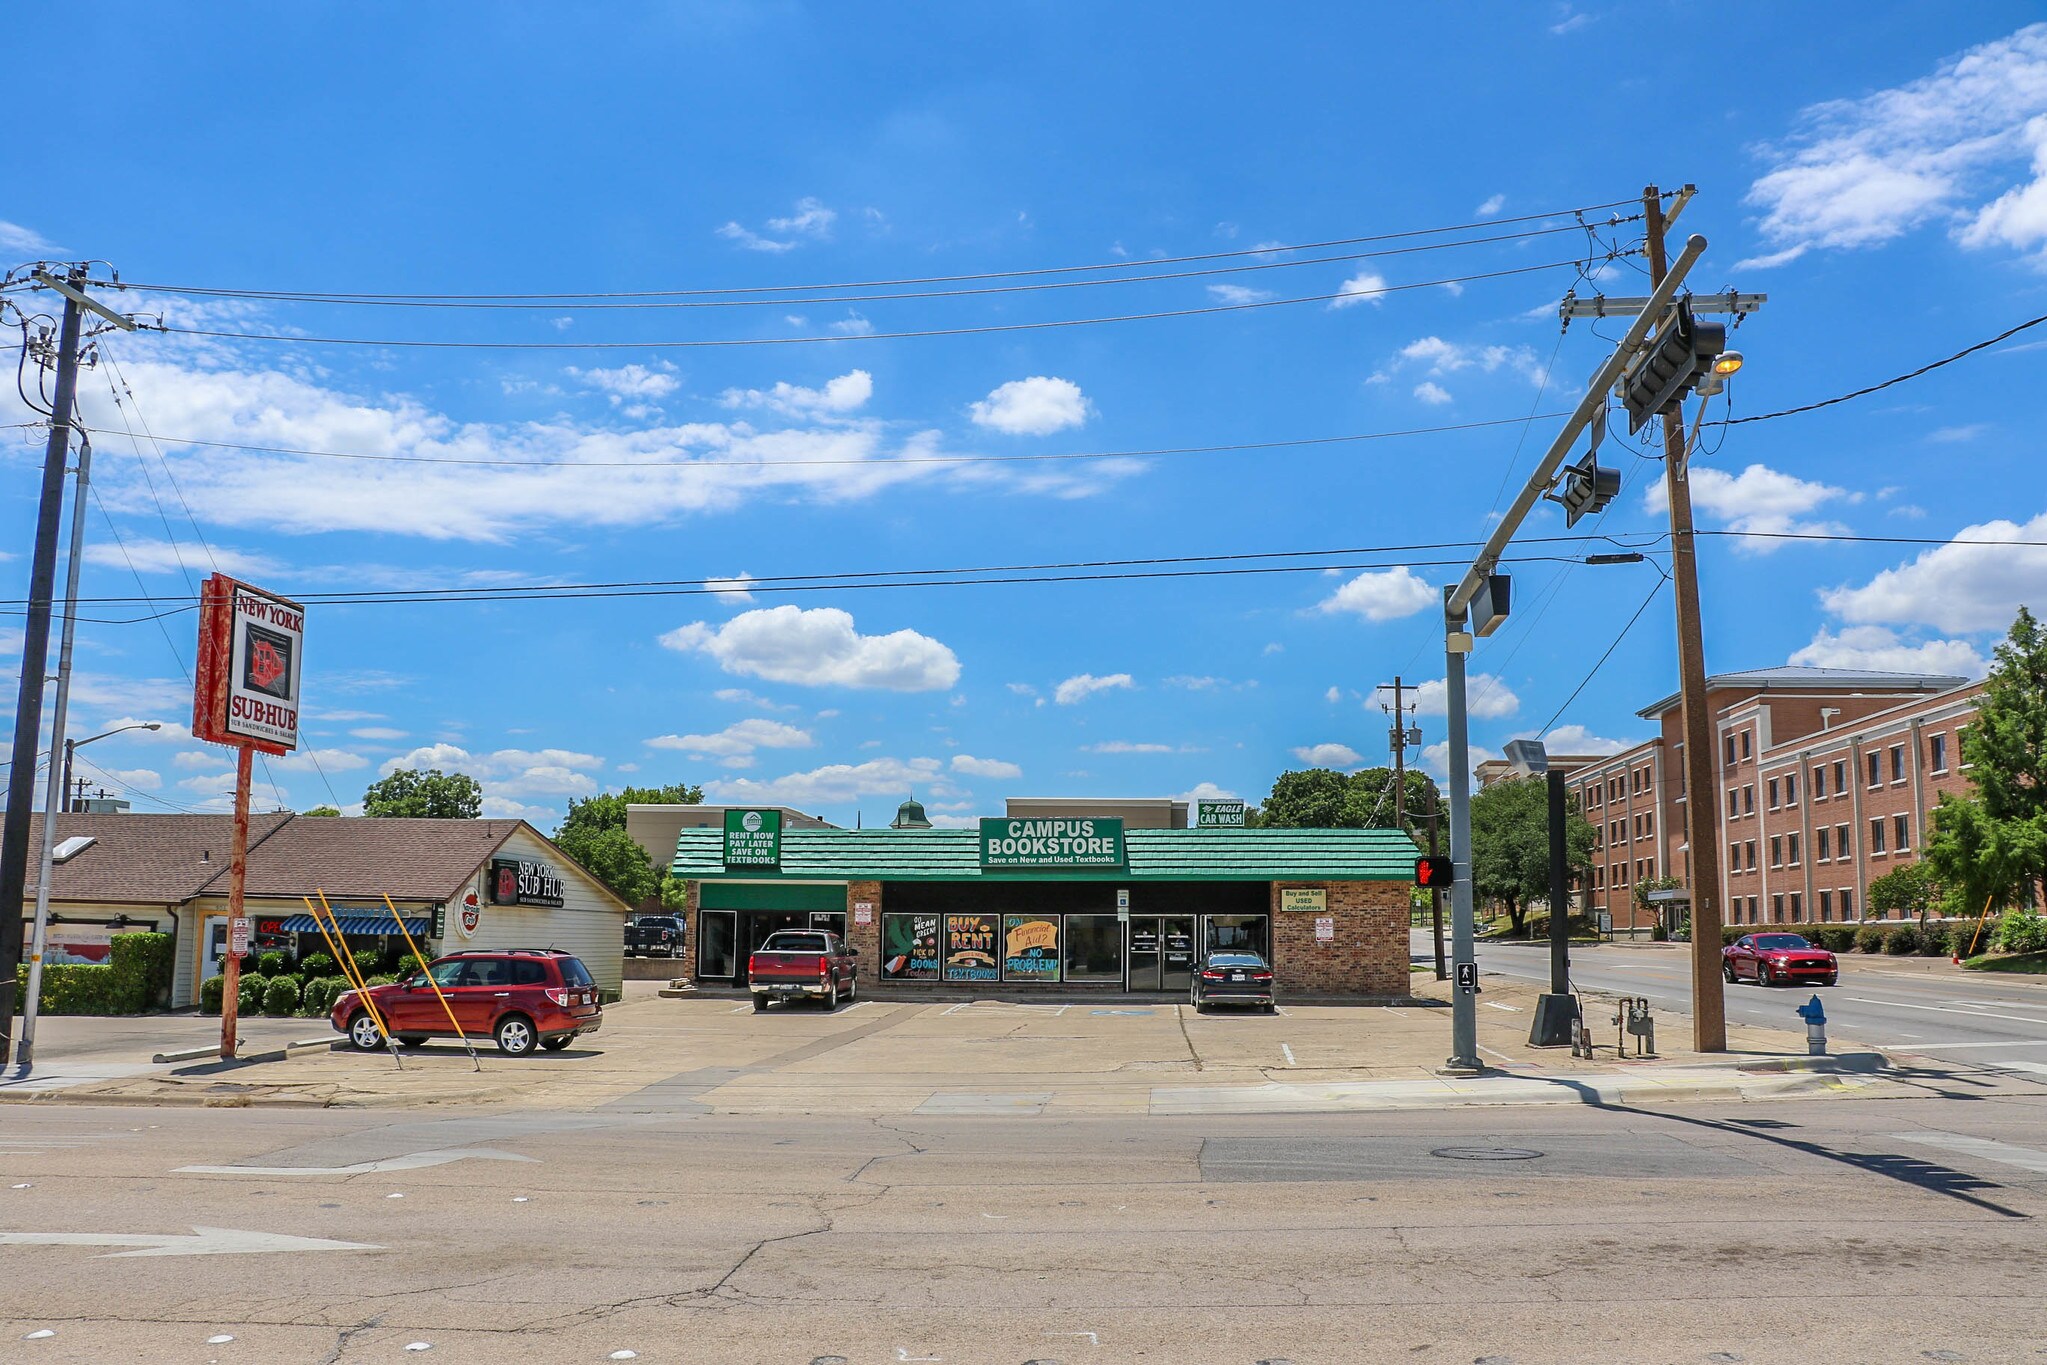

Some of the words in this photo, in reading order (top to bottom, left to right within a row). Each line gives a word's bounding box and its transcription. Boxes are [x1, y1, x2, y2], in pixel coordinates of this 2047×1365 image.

[238, 594, 268, 620] NEW
[270, 606, 302, 632] YORK
[242, 722, 273, 734] SANDWICHES
[1200, 814, 1216, 823] CAR
[1218, 814, 1242, 823] WASH
[1008, 821, 1094, 837] CAMPUS
[988, 838, 1114, 855] BOOKSTORE
[518, 861, 535, 876] NEW
[536, 864, 555, 878] YORK
[518, 875, 540, 894] SUB
[543, 877, 566, 897] HUB
[260, 921, 282, 933] OPE
[914, 919, 936, 930] MEAN
[948, 917, 980, 932] BUY
[1015, 924, 1050, 942] Financial
[951, 932, 993, 949] RENT
[1026, 934, 1047, 947] Aid?
[1030, 949, 1042, 957] NO
[911, 959, 938, 969] BOOKS
[1007, 959, 1057, 971] PROBLEM!
[948, 968, 997, 980] TEXTBOOKS
